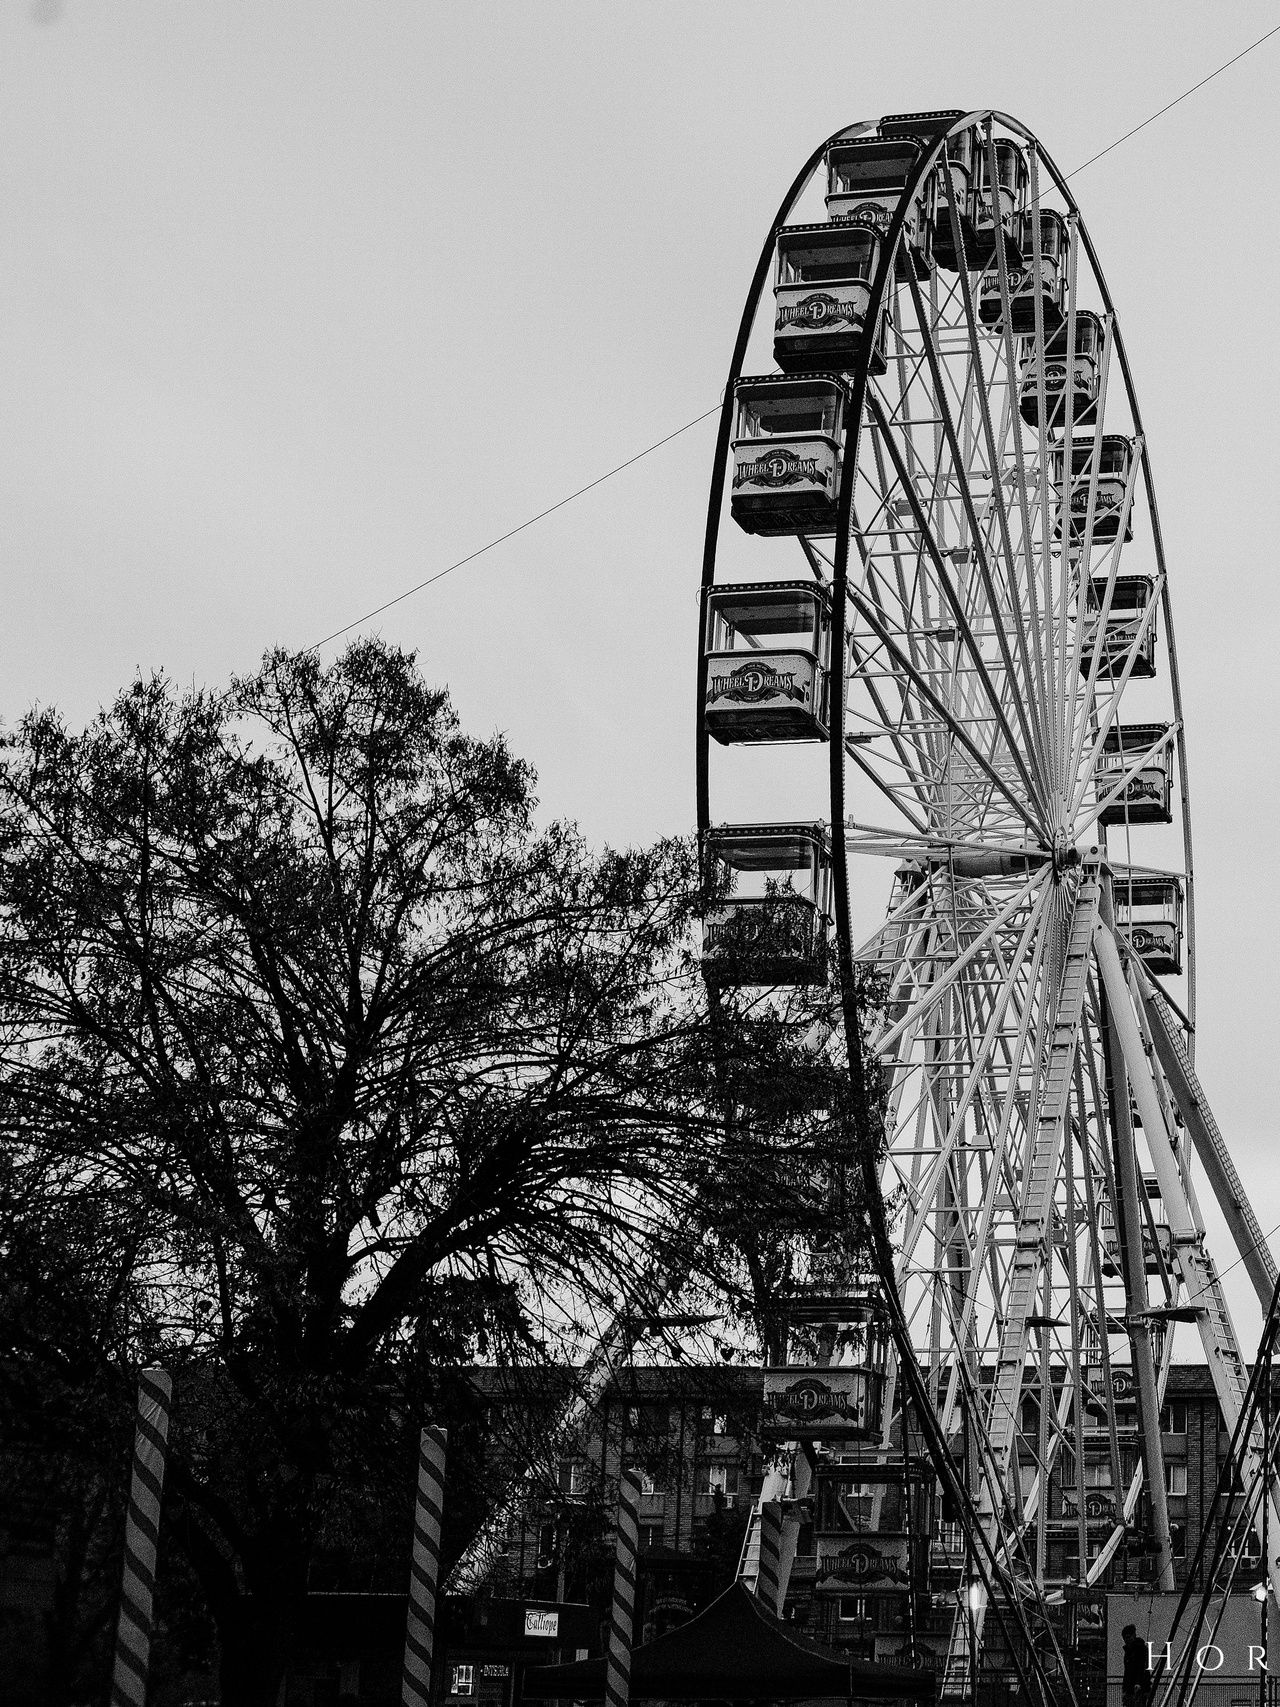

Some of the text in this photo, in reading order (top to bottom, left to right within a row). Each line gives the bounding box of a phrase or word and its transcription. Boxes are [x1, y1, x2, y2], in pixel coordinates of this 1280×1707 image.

[780, 301, 854, 322] WHEEL DREAMS
[739, 458, 815, 479] WHEEL DREAMS
[712, 671, 793, 694] WHEEL DREAMS
[799, 1389, 847, 1411] DREAMS
[527, 1613, 557, 1635] Calliope
